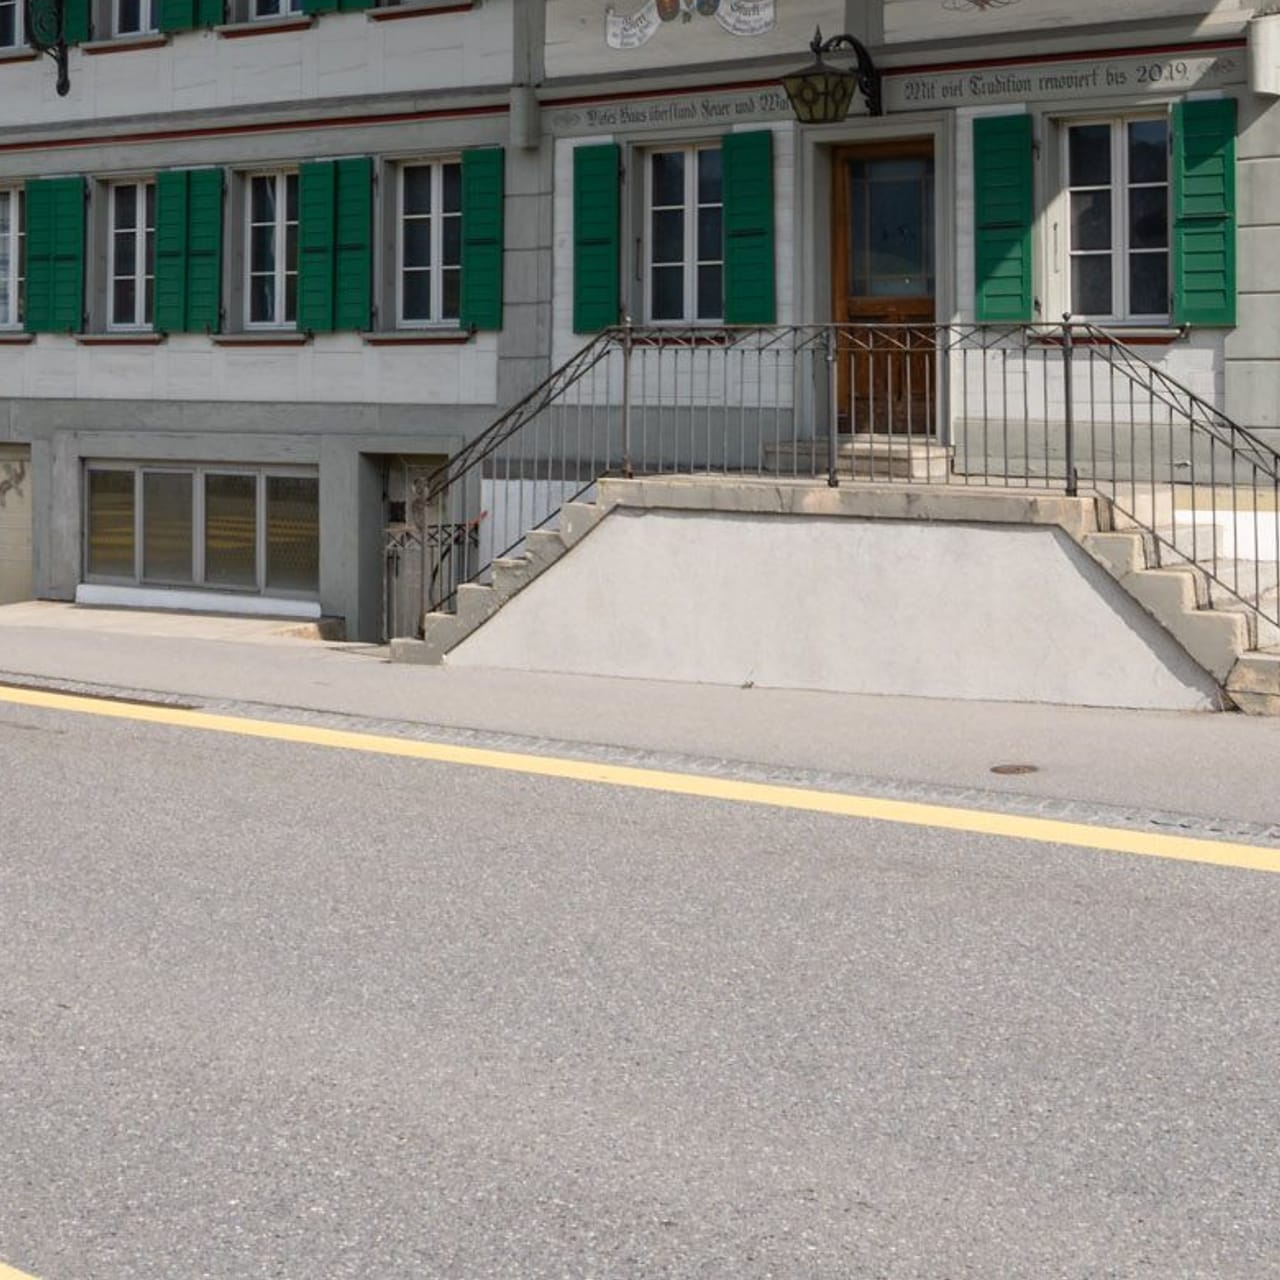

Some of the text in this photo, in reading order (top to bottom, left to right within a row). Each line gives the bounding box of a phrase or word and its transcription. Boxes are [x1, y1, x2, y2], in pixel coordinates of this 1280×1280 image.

[904, 79, 935, 101] Mit
[941, 76, 963, 97] viel
[970, 72, 1032, 97] Tradition
[1038, 69, 1097, 92] renoviert
[1105, 67, 1127, 87] bis
